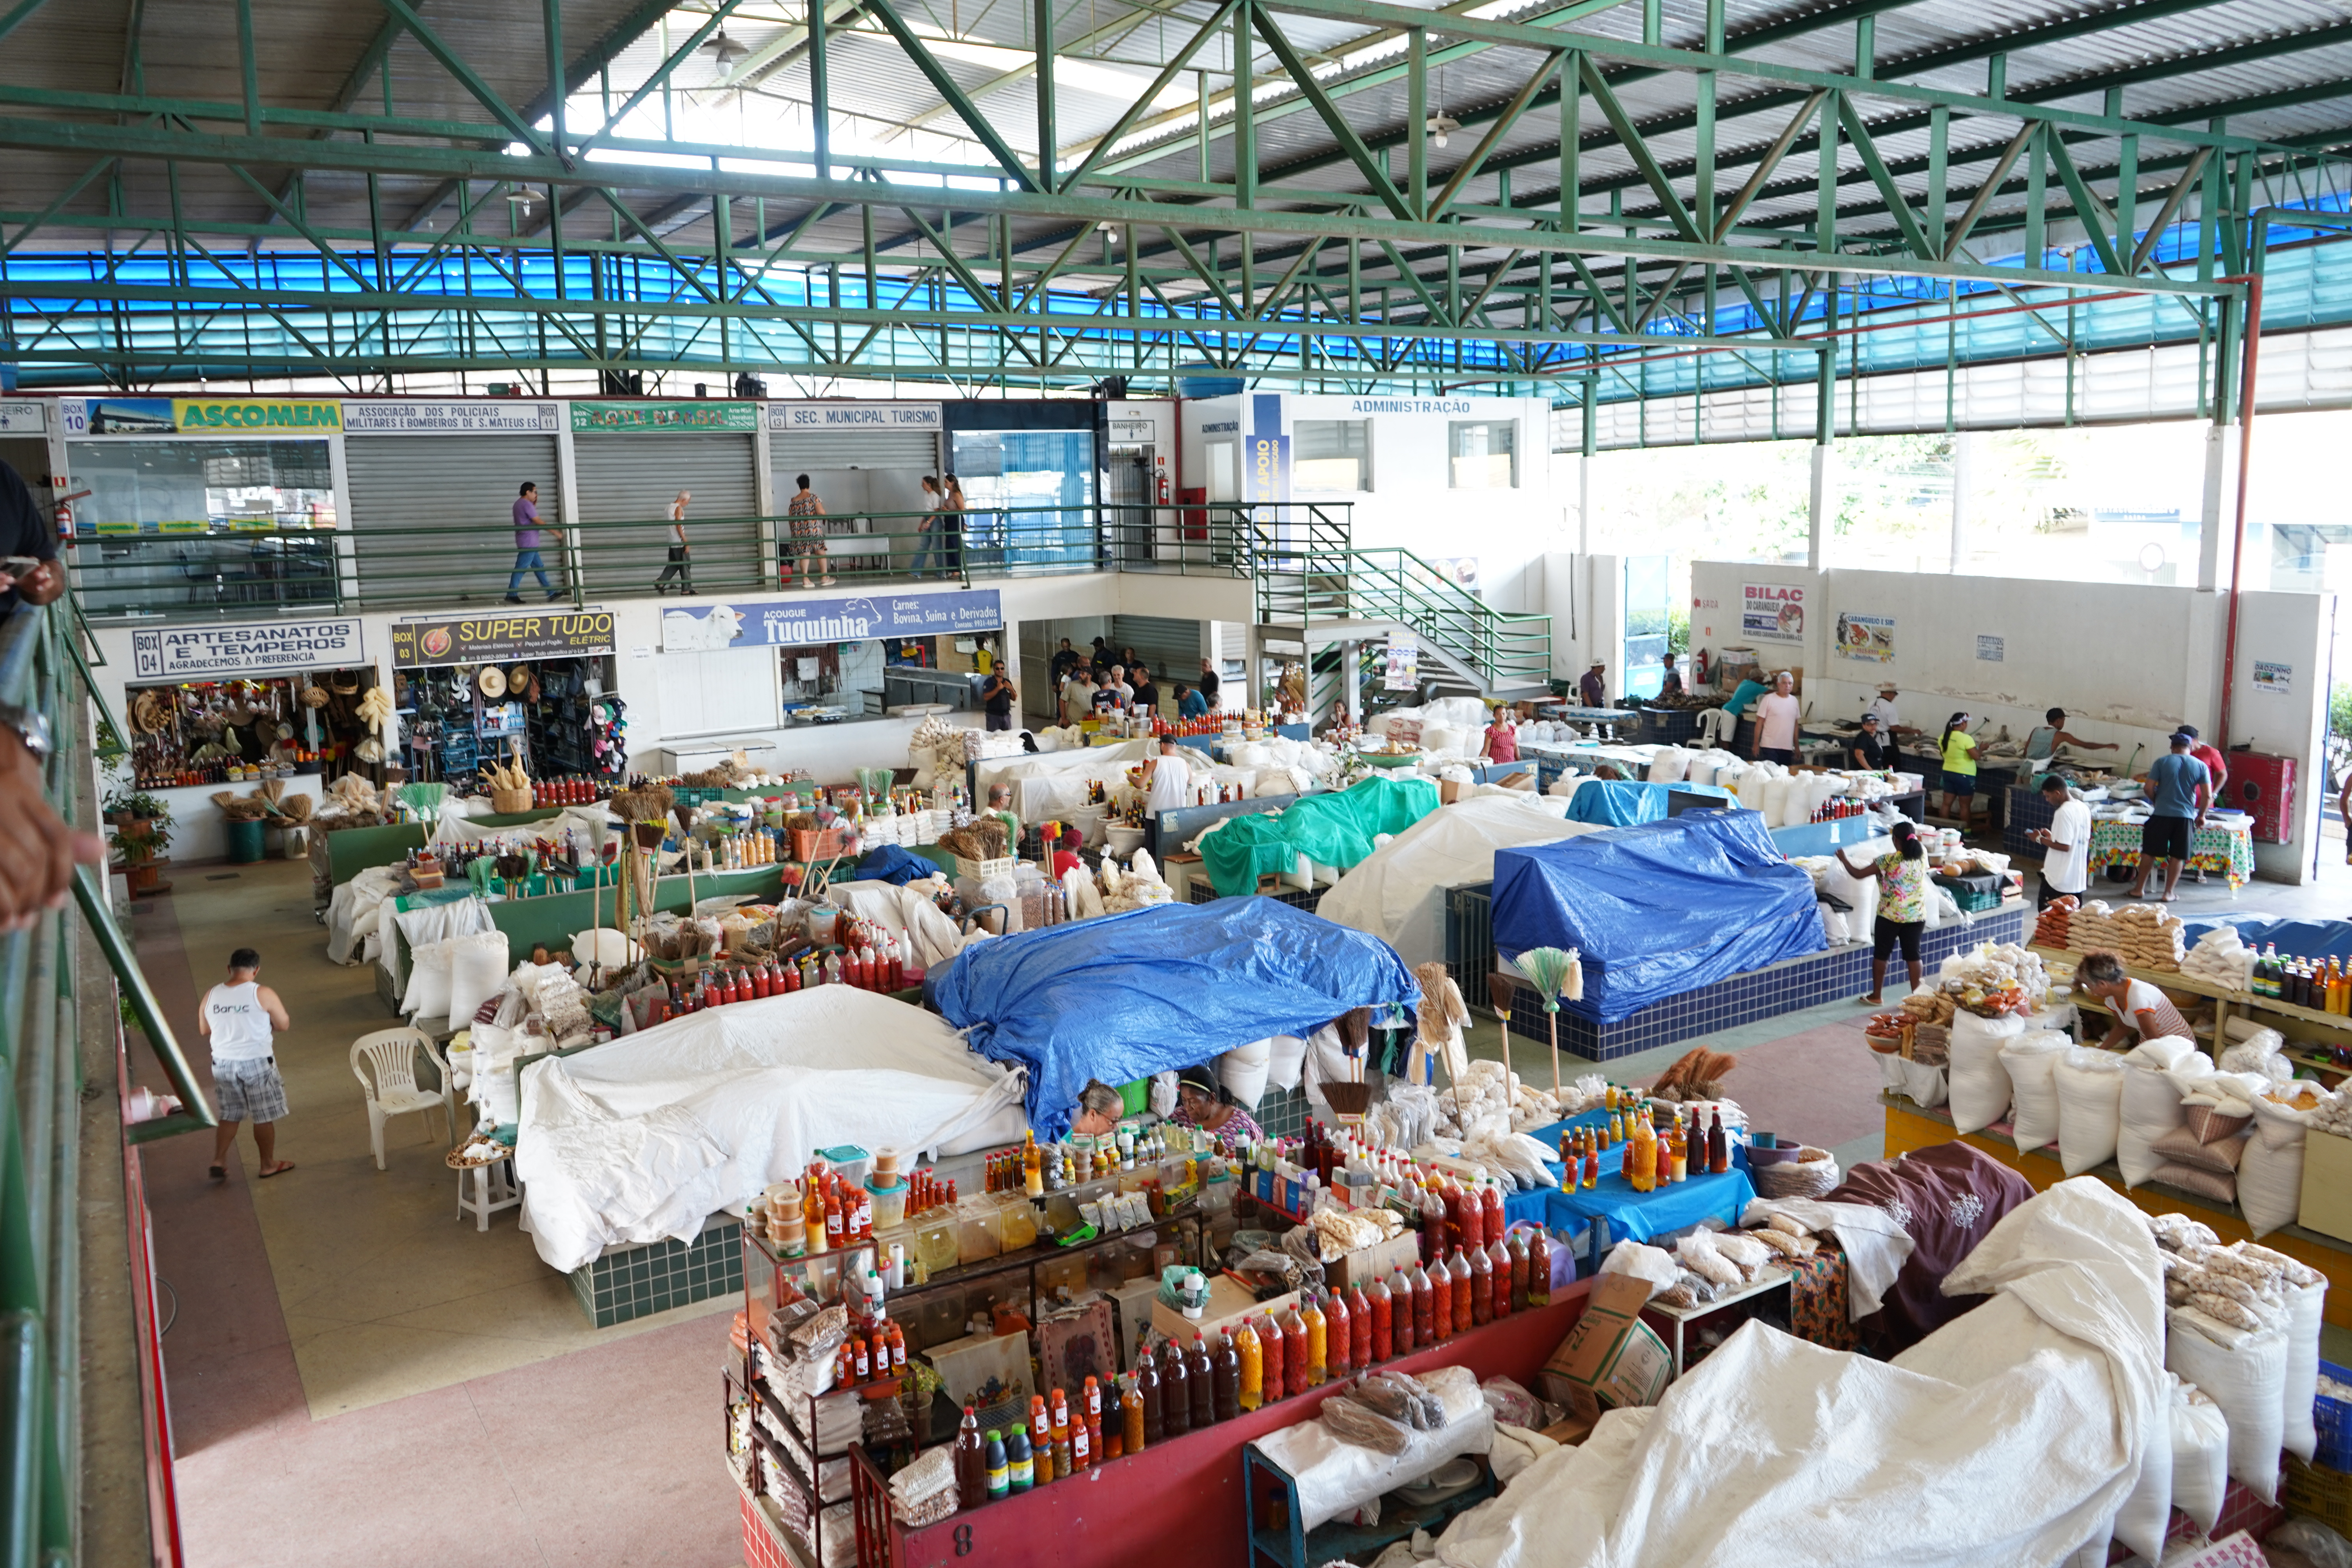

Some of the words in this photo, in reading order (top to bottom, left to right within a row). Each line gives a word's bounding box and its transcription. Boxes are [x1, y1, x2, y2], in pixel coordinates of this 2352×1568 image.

[64, 405, 83, 414] BOX
[359, 405, 416, 418] ASSOCIAÇÃO
[425, 407, 444, 416] DOS
[451, 407, 499, 416] POLICIAIS
[541, 407, 555, 416] BOX
[771, 408, 784, 416] BOX
[1352, 399, 1470, 416] ADMINISTRAÇÃO
[182, 405, 339, 426] ASCOMEM
[574, 417, 588, 426] 12
[590, 410, 646, 426] ARTE
[653, 410, 728, 425] BRASIL
[795, 411, 820, 423] SEC.
[827, 410, 885, 423] MUNICIPAL
[891, 410, 937, 423] TURISMO
[66, 416, 84, 430] 10
[347, 417, 396, 428] MILITARES
[407, 418, 458, 428] BOMBEIROS
[463, 418, 474, 428] DE
[544, 419, 553, 428] 11
[773, 419, 781, 427] 13
[1202, 420, 1239, 434] ADMINISTRAÇÃO
[1256, 439, 1270, 486] APOIO
[1745, 586, 1803, 602] BILAC
[893, 600, 919, 611] Carnes:
[1746, 600, 1752, 610] DO
[1753, 601, 1780, 612] CARANGUEJO
[764, 609, 807, 619] AÇOUGUE
[893, 612, 923, 624] Bovina,
[926, 610, 947, 622] Suína
[960, 607, 997, 620] Derivados
[1848, 615, 1880, 625] CARANGUEJO
[459, 618, 541, 642] SUPER
[548, 614, 612, 635] TUDO
[763, 615, 870, 644] Tuquinha
[955, 621, 973, 629] Contato:
[165, 624, 350, 646] ARTESANATOS
[394, 632, 413, 643] BOX
[137, 635, 158, 651] BOX
[176, 648, 192, 659] E
[206, 637, 346, 656] TEMPEROS
[399, 649, 410, 659] 03
[141, 654, 157, 671] 04
[169, 657, 241, 670] AGRADECEMOS
[256, 652, 316, 664] PREFERENCIA
[214, 1004, 249, 1014] Baruc
[955, 1523, 973, 1557] 8
